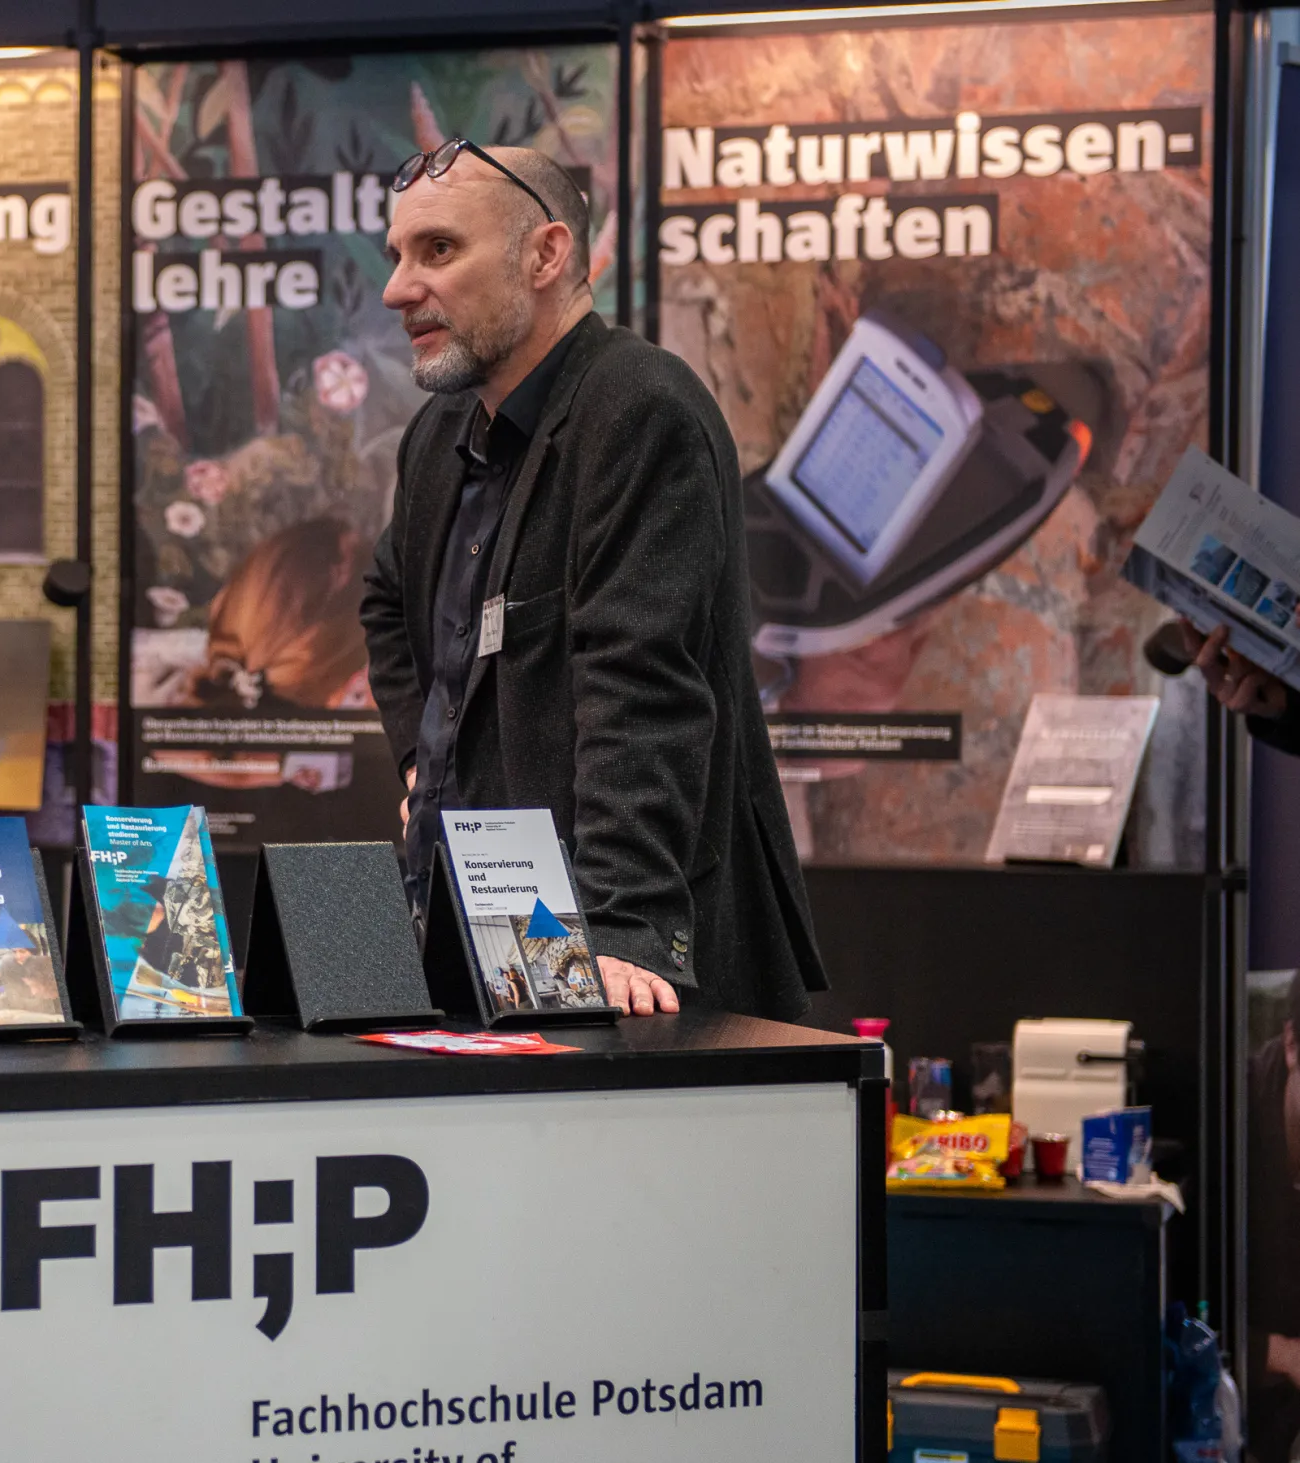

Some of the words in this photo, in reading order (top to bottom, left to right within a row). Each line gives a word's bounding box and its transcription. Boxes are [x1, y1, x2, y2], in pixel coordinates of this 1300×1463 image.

[663, 111, 1194, 189] Naturwissen-
[132, 172, 399, 239] Gestalt
[657, 193, 993, 265] schaften
[132, 249, 320, 312] lehre
[105, 815, 152, 825] Konservierung
[121, 823, 167, 833] Restaurierung
[454, 822, 482, 833] FH;P
[140, 839, 153, 847] Arts
[90, 850, 127, 865] FH;P
[464, 859, 534, 869] Konservierung
[467, 872, 487, 881] und
[471, 884, 539, 894] Restaurierung
[0, 1153, 430, 1341] FH;P
[252, 1380, 576, 1438] Fachhochschule
[592, 1372, 763, 1417] Potsdam
